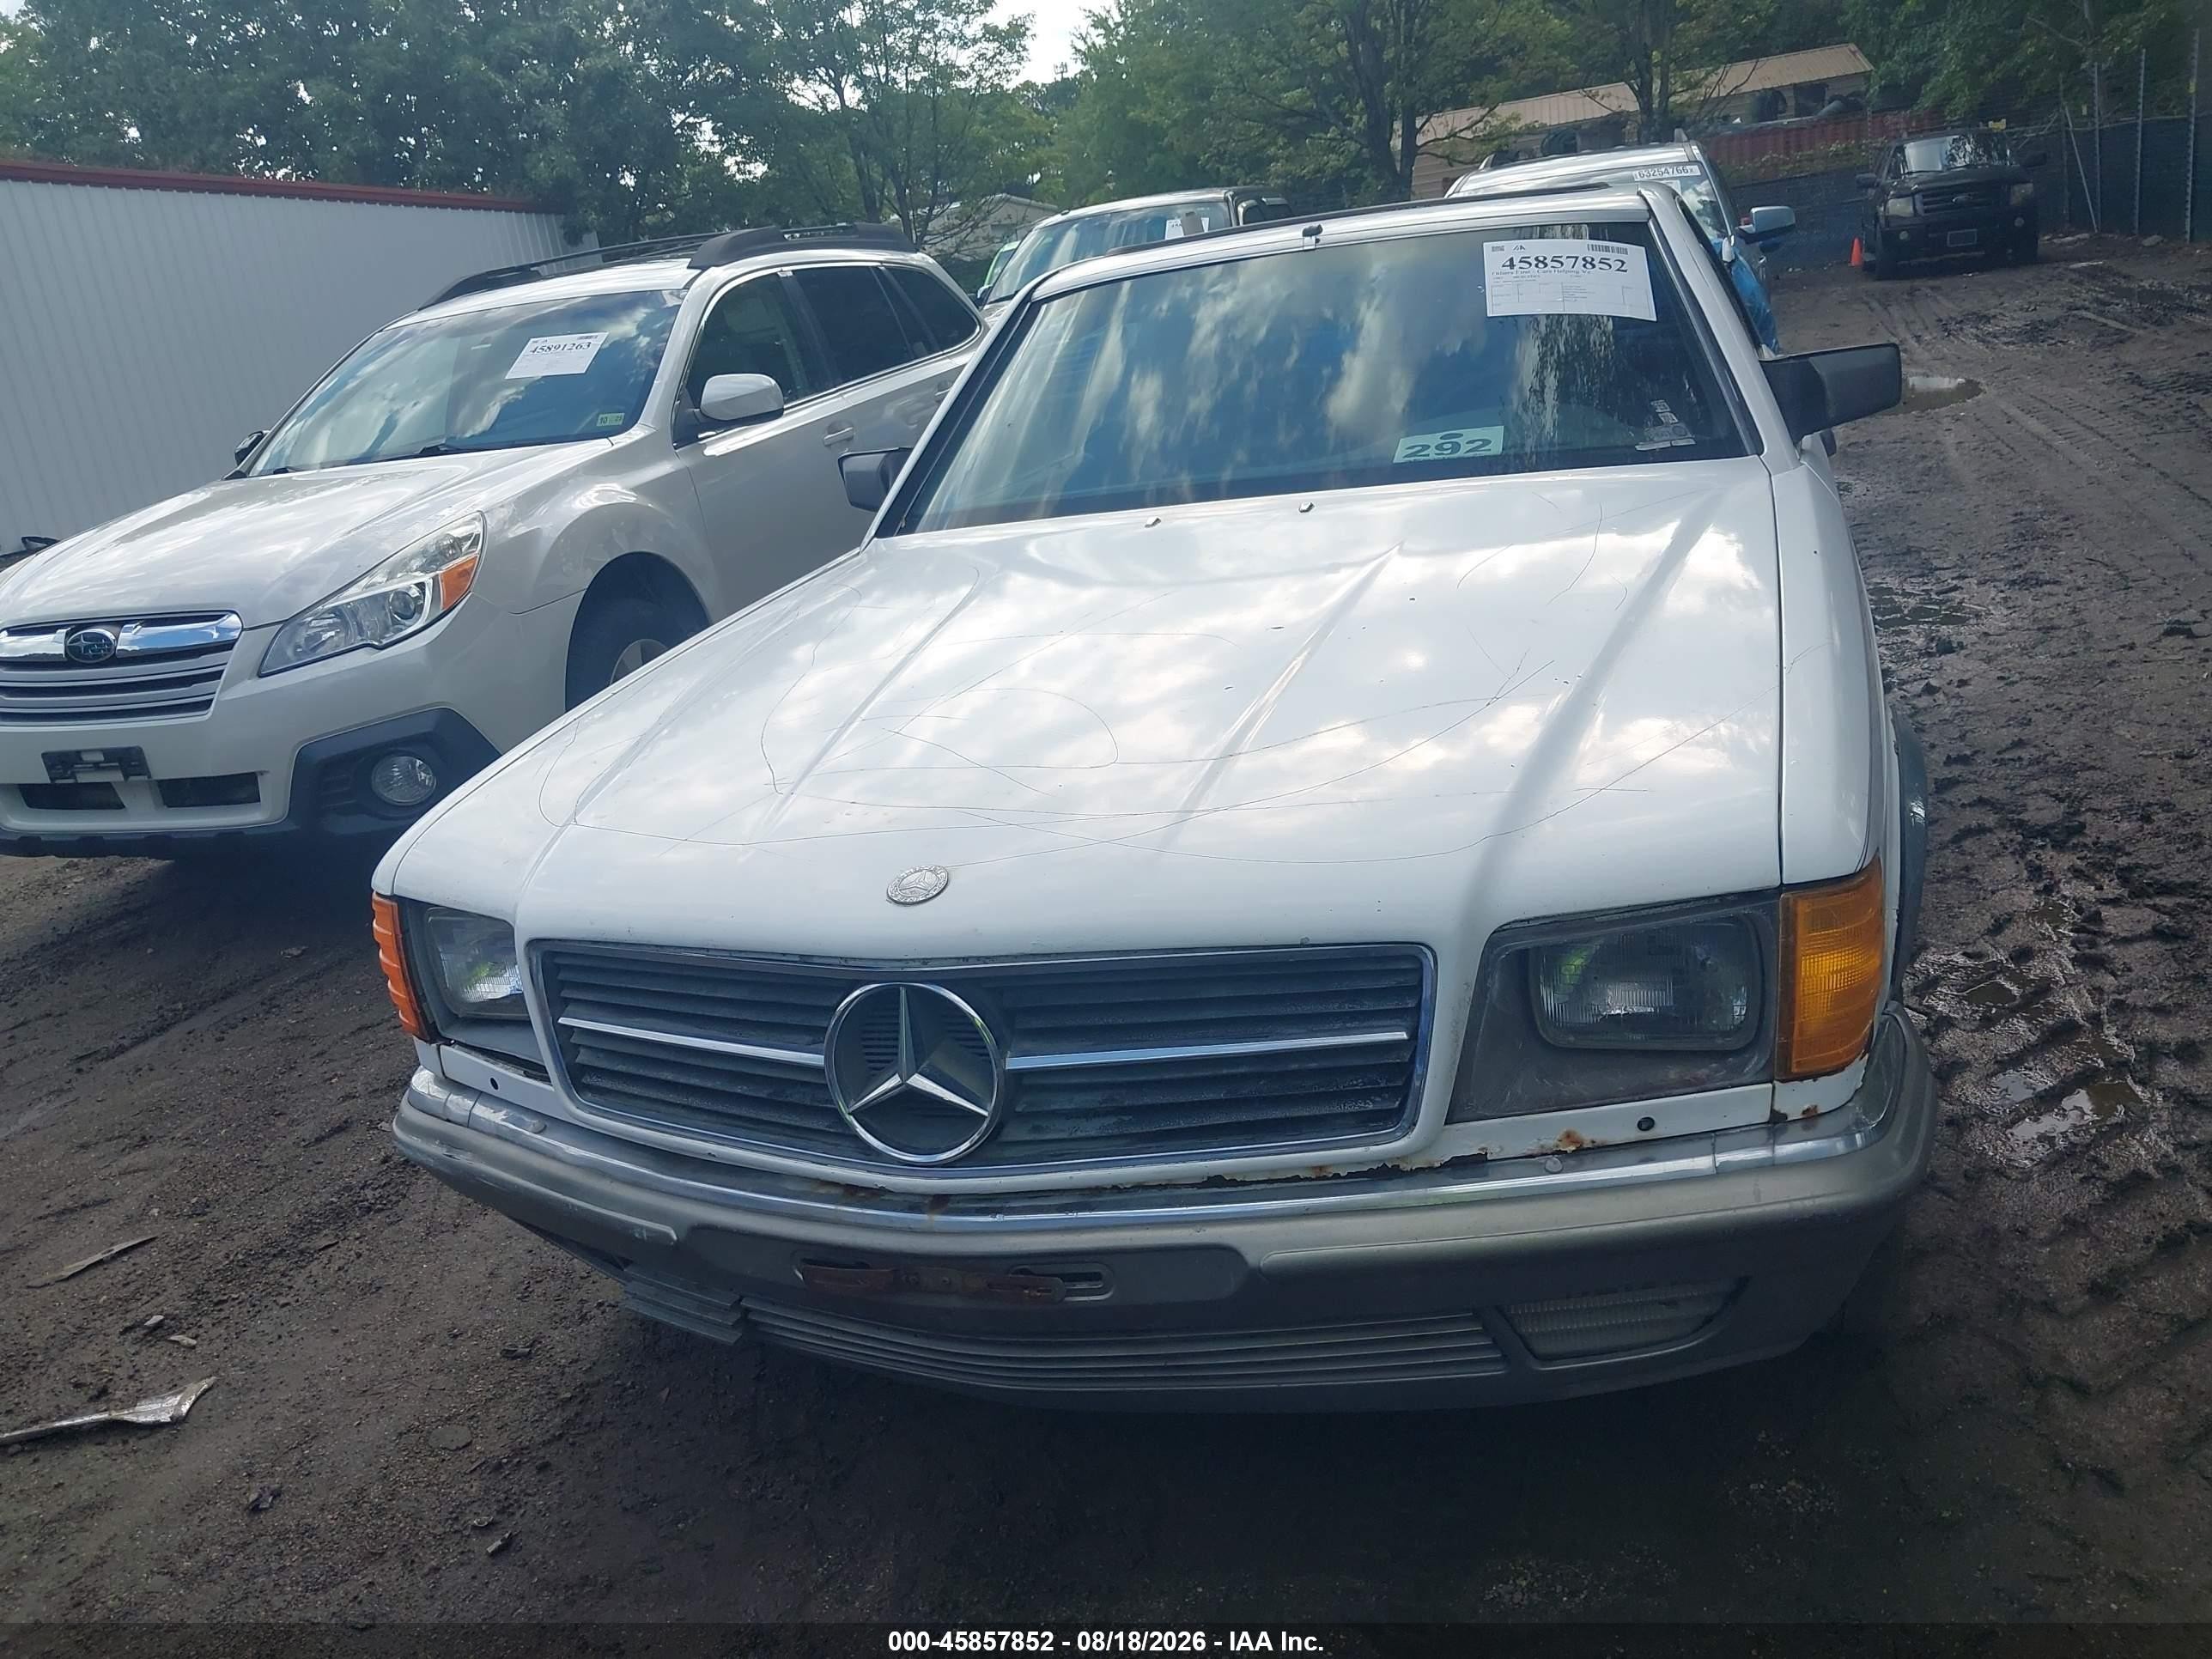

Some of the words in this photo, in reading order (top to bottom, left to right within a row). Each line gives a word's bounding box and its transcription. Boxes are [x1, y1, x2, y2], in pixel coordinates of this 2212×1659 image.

[1638, 166, 1689, 179] 63254766
[1502, 255, 1628, 273] 45857852
[529, 341, 592, 354] 45891263
[1402, 438, 1492, 459] 292
